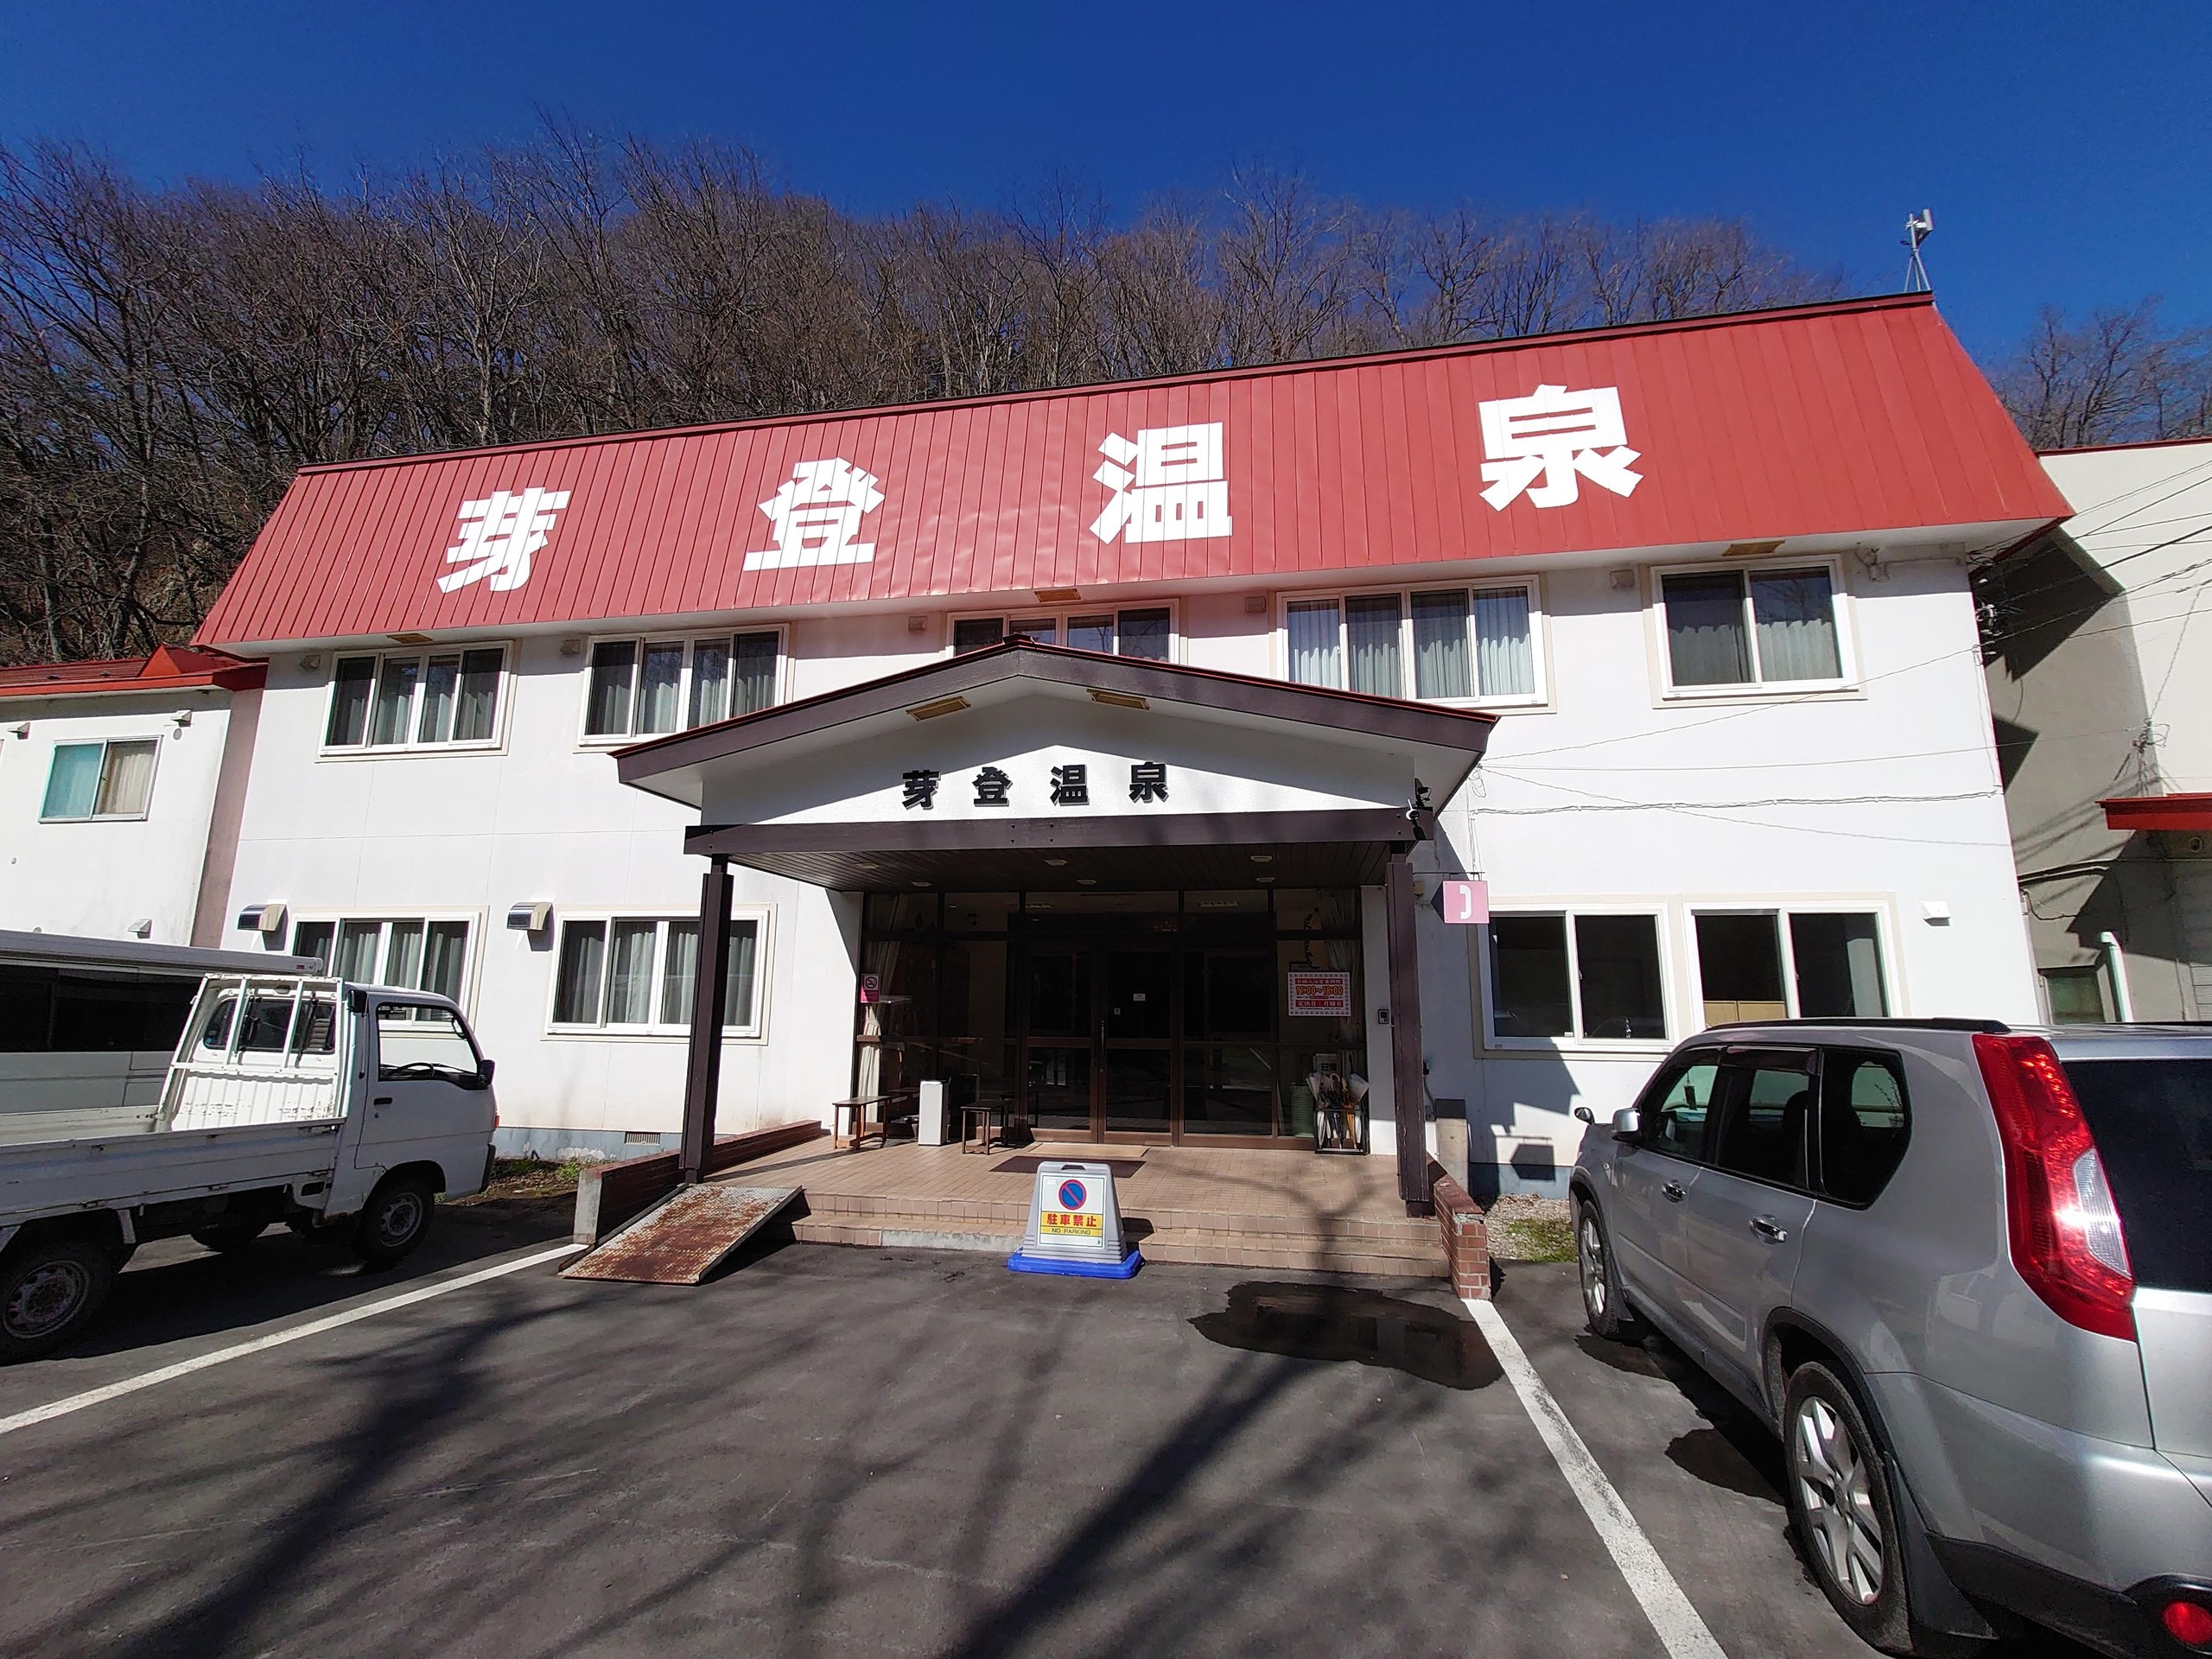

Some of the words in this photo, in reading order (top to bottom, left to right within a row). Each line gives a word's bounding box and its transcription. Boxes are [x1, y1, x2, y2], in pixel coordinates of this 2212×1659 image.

[436, 385, 1643, 594] 芽登温泉
[901, 761, 1169, 810] 芽登温泉
[1046, 1213, 1096, 1227] 駐車禁止
